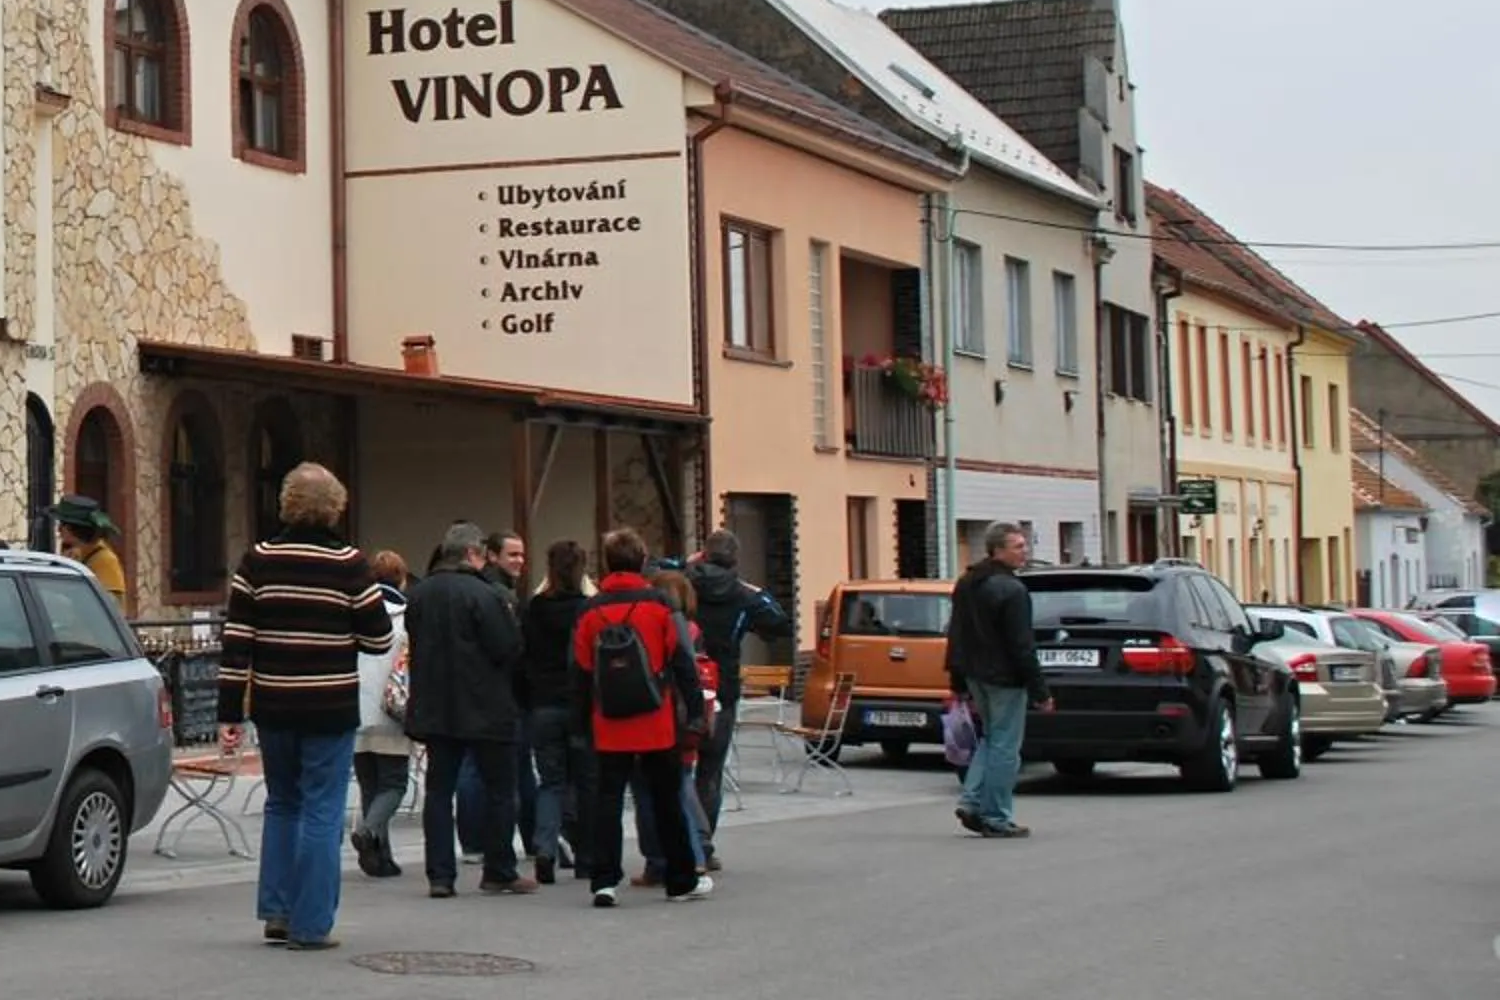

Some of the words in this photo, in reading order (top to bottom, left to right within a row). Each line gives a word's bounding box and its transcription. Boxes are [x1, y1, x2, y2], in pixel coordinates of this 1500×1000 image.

[367, 0, 515, 55] Hotel
[390, 64, 624, 123] VINOPA
[498, 179, 626, 209] Ubytování
[499, 216, 641, 238] Restaurace
[498, 248, 599, 270] Vinárna
[500, 280, 583, 302] Archiv
[501, 312, 555, 334] Golf
